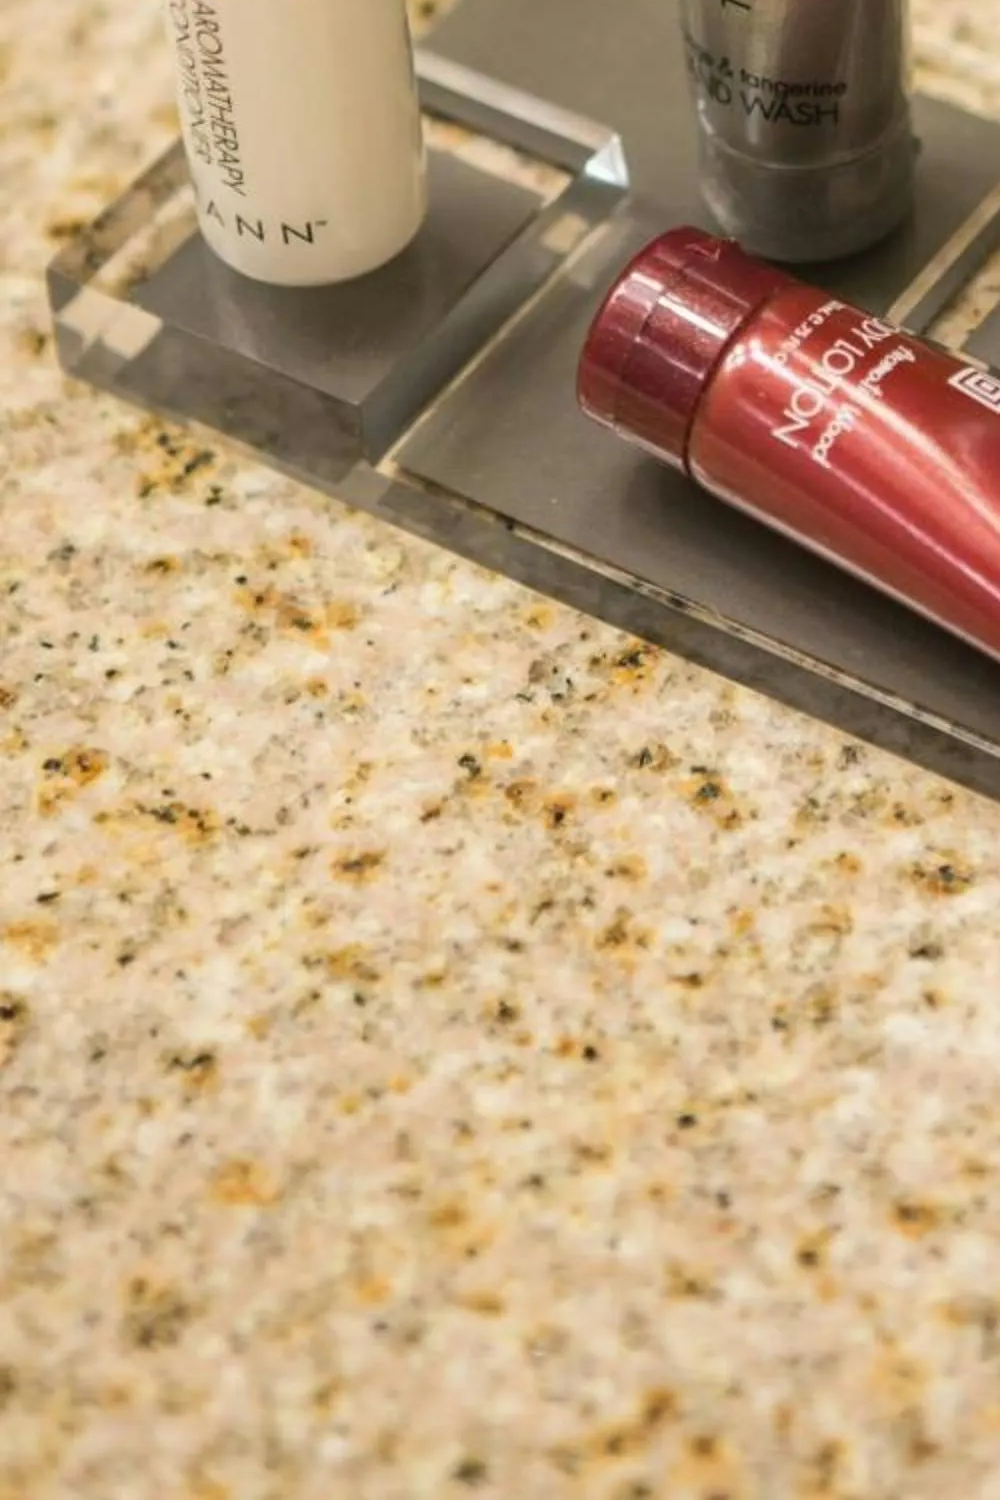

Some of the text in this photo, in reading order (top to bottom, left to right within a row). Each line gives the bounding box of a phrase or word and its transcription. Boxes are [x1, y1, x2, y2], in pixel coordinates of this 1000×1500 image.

[739, 88, 839, 126] WASH
[206, 200, 314, 245] ANN
[771, 340, 864, 448] LOTION
